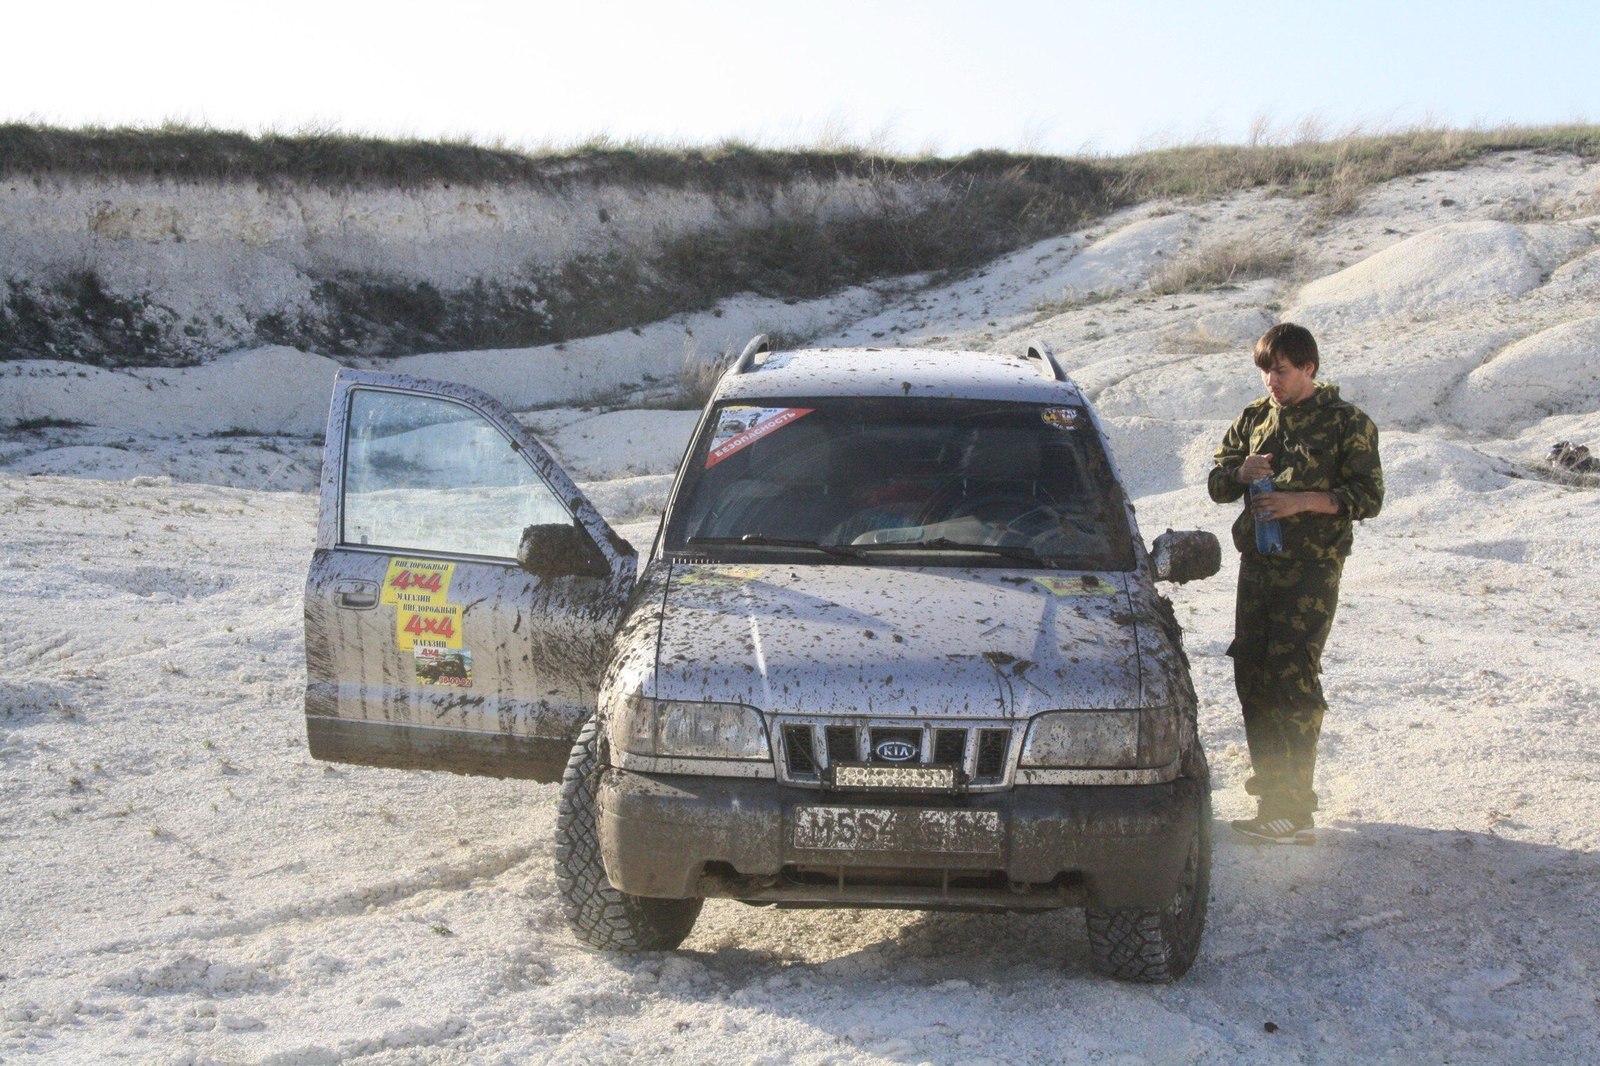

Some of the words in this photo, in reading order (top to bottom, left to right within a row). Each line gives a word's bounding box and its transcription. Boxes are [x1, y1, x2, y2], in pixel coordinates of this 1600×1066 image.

[714, 412, 797, 457] БЕЗОПАСНОСТЬ
[394, 560, 449, 571] ВНЕДОРОЖНЫЙ
[397, 593, 431, 602] МАГАЗИН
[403, 604, 457, 614] ВНЕДОРОЖНЫЙ
[413, 639, 447, 648] МАГАЗИН
[884, 745, 908, 757] KIA
